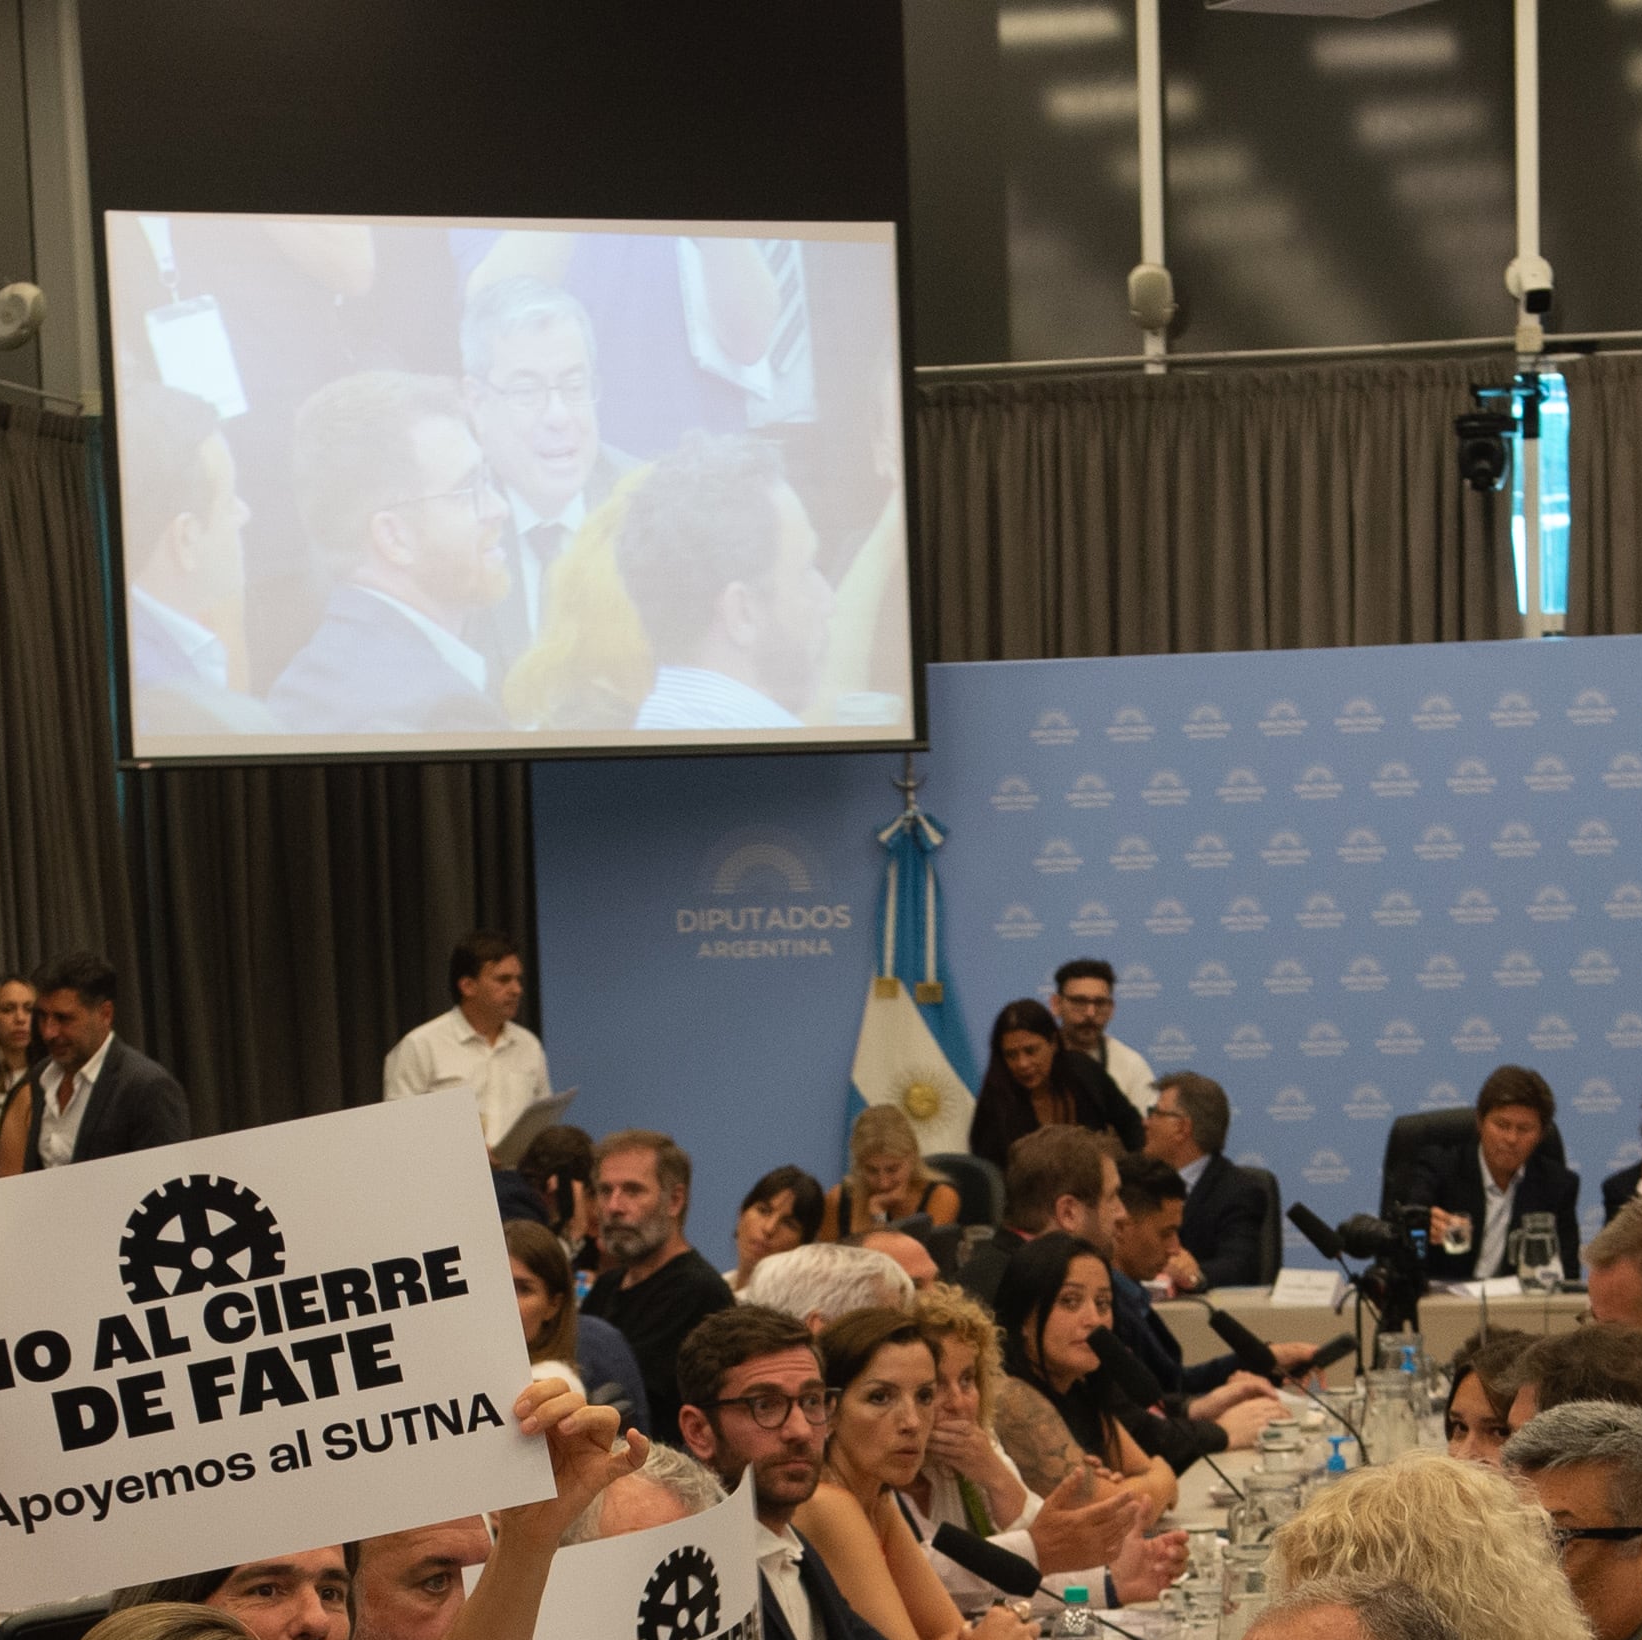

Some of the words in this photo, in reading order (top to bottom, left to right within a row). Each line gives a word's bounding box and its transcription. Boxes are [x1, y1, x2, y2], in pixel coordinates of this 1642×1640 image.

[676, 905, 852, 934] DIPUTADOS
[698, 939, 833, 959] ARGENTINA
[94, 1308, 190, 1370] AL
[201, 1246, 469, 1343] CIERRE
[51, 1372, 173, 1452] DE
[188, 1323, 402, 1425] FATE
[269, 1428, 310, 1473] al
[322, 1391, 504, 1462] SUTNA
